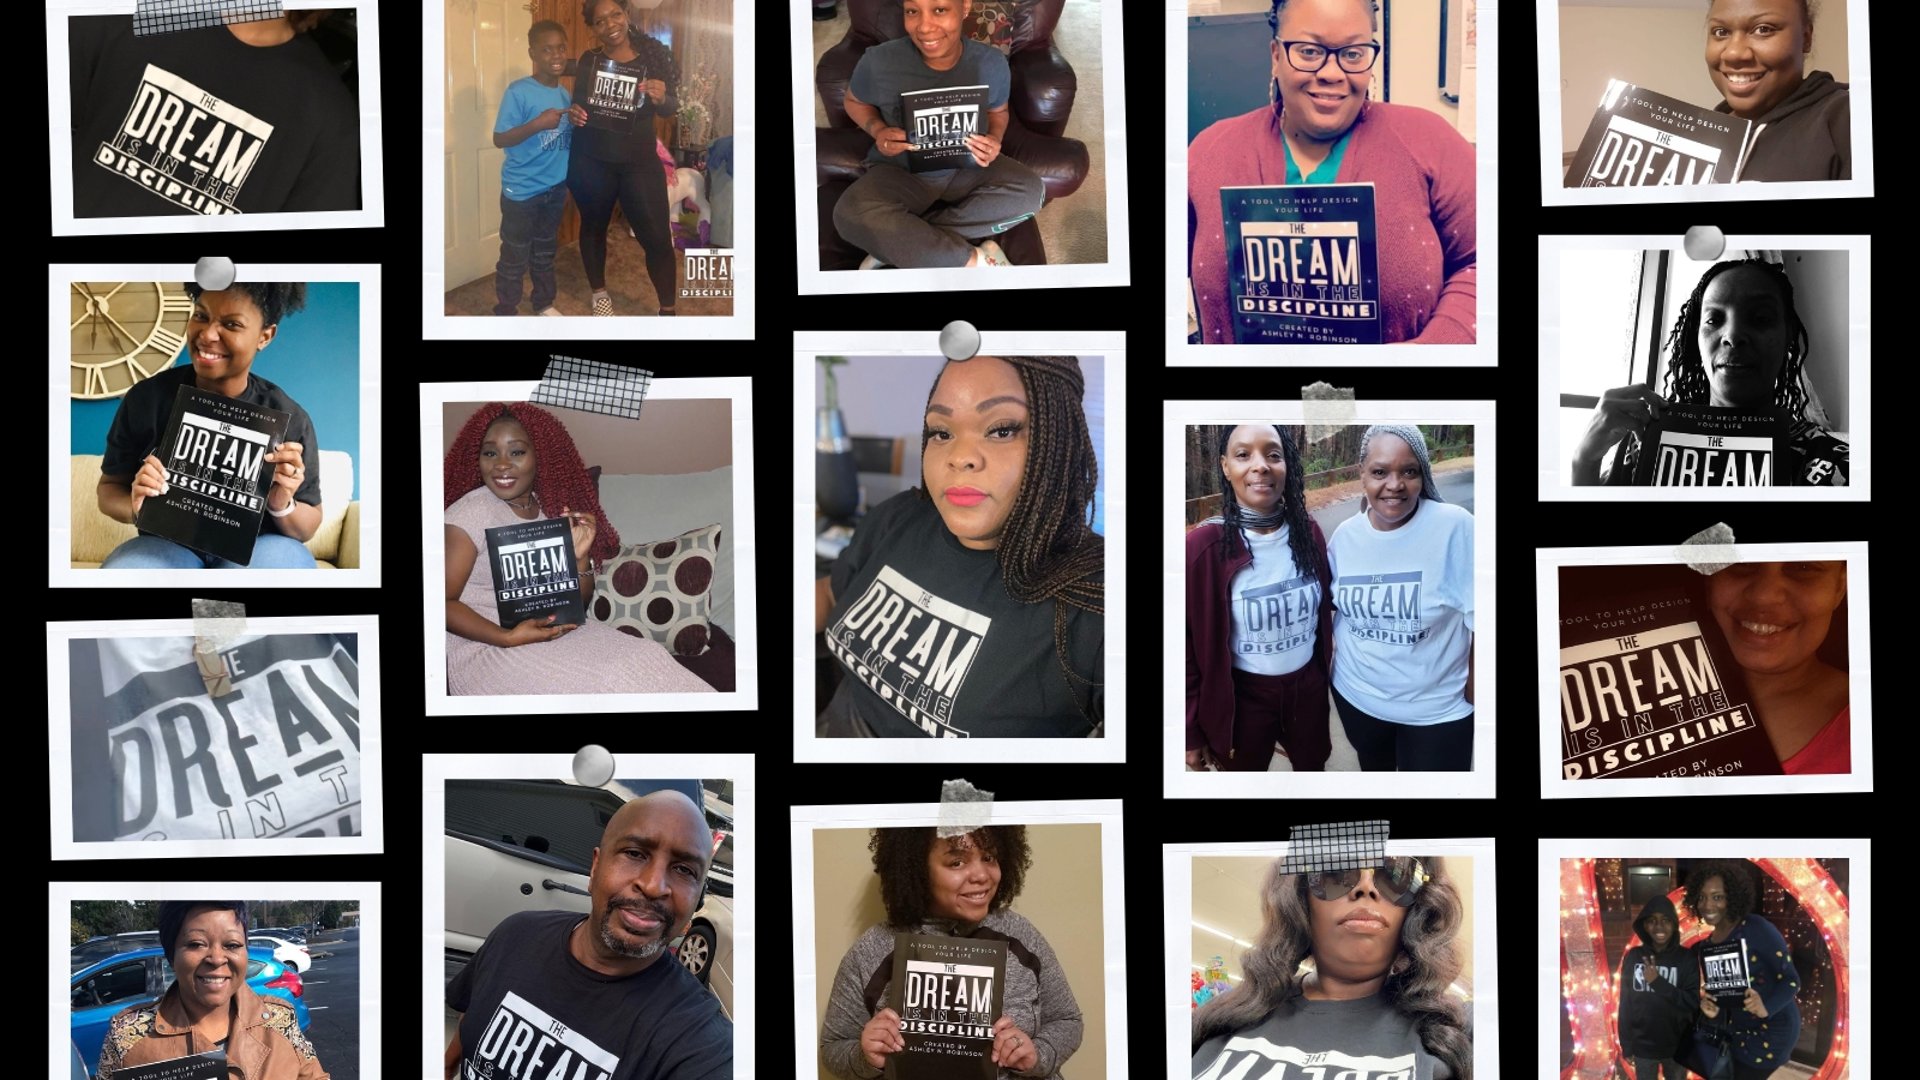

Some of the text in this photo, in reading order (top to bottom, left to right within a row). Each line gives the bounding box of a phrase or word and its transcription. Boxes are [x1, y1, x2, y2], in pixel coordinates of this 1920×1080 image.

[595, 76, 637, 99] DREAM
[200, 93, 219, 112] THE
[916, 112, 978, 137] DREAM
[1632, 98, 1653, 110] TOOL
[1657, 104, 1668, 114] TO
[1672, 110, 1694, 122] HELP
[1697, 118, 1730, 133] DESIGN
[1650, 112, 1696, 132] YOUR LIFE
[124, 82, 263, 188] DREAM
[1655, 131, 1673, 146] THE
[115, 133, 236, 206] IS IN THE
[1289, 223, 1306, 235] THE
[1245, 237, 1359, 286] DREAM
[1247, 282, 1361, 301] IS IN THE
[1242, 299, 1371, 318] DISCIPLINE
[1261, 329, 1294, 339] ASHLEY
[1309, 333, 1358, 344] ROBINSON
[1279, 323, 1320, 334] CREATED
[218, 422, 232, 434] THE
[1697, 421, 1719, 430] YOUR
[1707, 436, 1723, 448] THE
[174, 424, 266, 482] DREAM
[168, 459, 186, 473] IS
[1655, 446, 1771, 486] DREAM
[165, 470, 259, 509] DISCIPLINE
[166, 499, 192, 513] ASHLEY
[203, 510, 241, 528] ROBINSON
[181, 497, 225, 516] CREATED BY
[501, 545, 567, 582] DREAM
[502, 580, 576, 600] DISCIPLINE
[919, 591, 934, 609] THE
[1338, 583, 1419, 620] DREAM
[1596, 611, 1611, 619] TO
[1617, 604, 1646, 617] HELP
[1651, 597, 1691, 610] DESIGN
[1593, 612, 1656, 631] YOUR LIFE
[843, 581, 980, 698] DREAM
[1243, 629, 1314, 654] DISCIPLI
[1616, 635, 1640, 651] THE
[832, 623, 951, 724] IS IN THE
[1560, 638, 1720, 732] DREAM
[1570, 690, 1728, 756] IS IN THE
[1564, 710, 1747, 779] DISCIPLINE
[1692, 758, 1708, 771] BY
[217, 791, 286, 839] IN
[944, 964, 957, 973] THE
[1705, 958, 1742, 978] DREAM
[906, 972, 992, 1014] DREAM
[905, 1007, 921, 1020] IS
[930, 1007, 948, 1022] IN
[549, 1019, 568, 1040] THE
[900, 1020, 995, 1038] DISCIPLINE
[909, 1045, 935, 1054] ASHLEY
[946, 1049, 984, 1057] ROBINSON
[923, 1041, 955, 1050] CREATED
